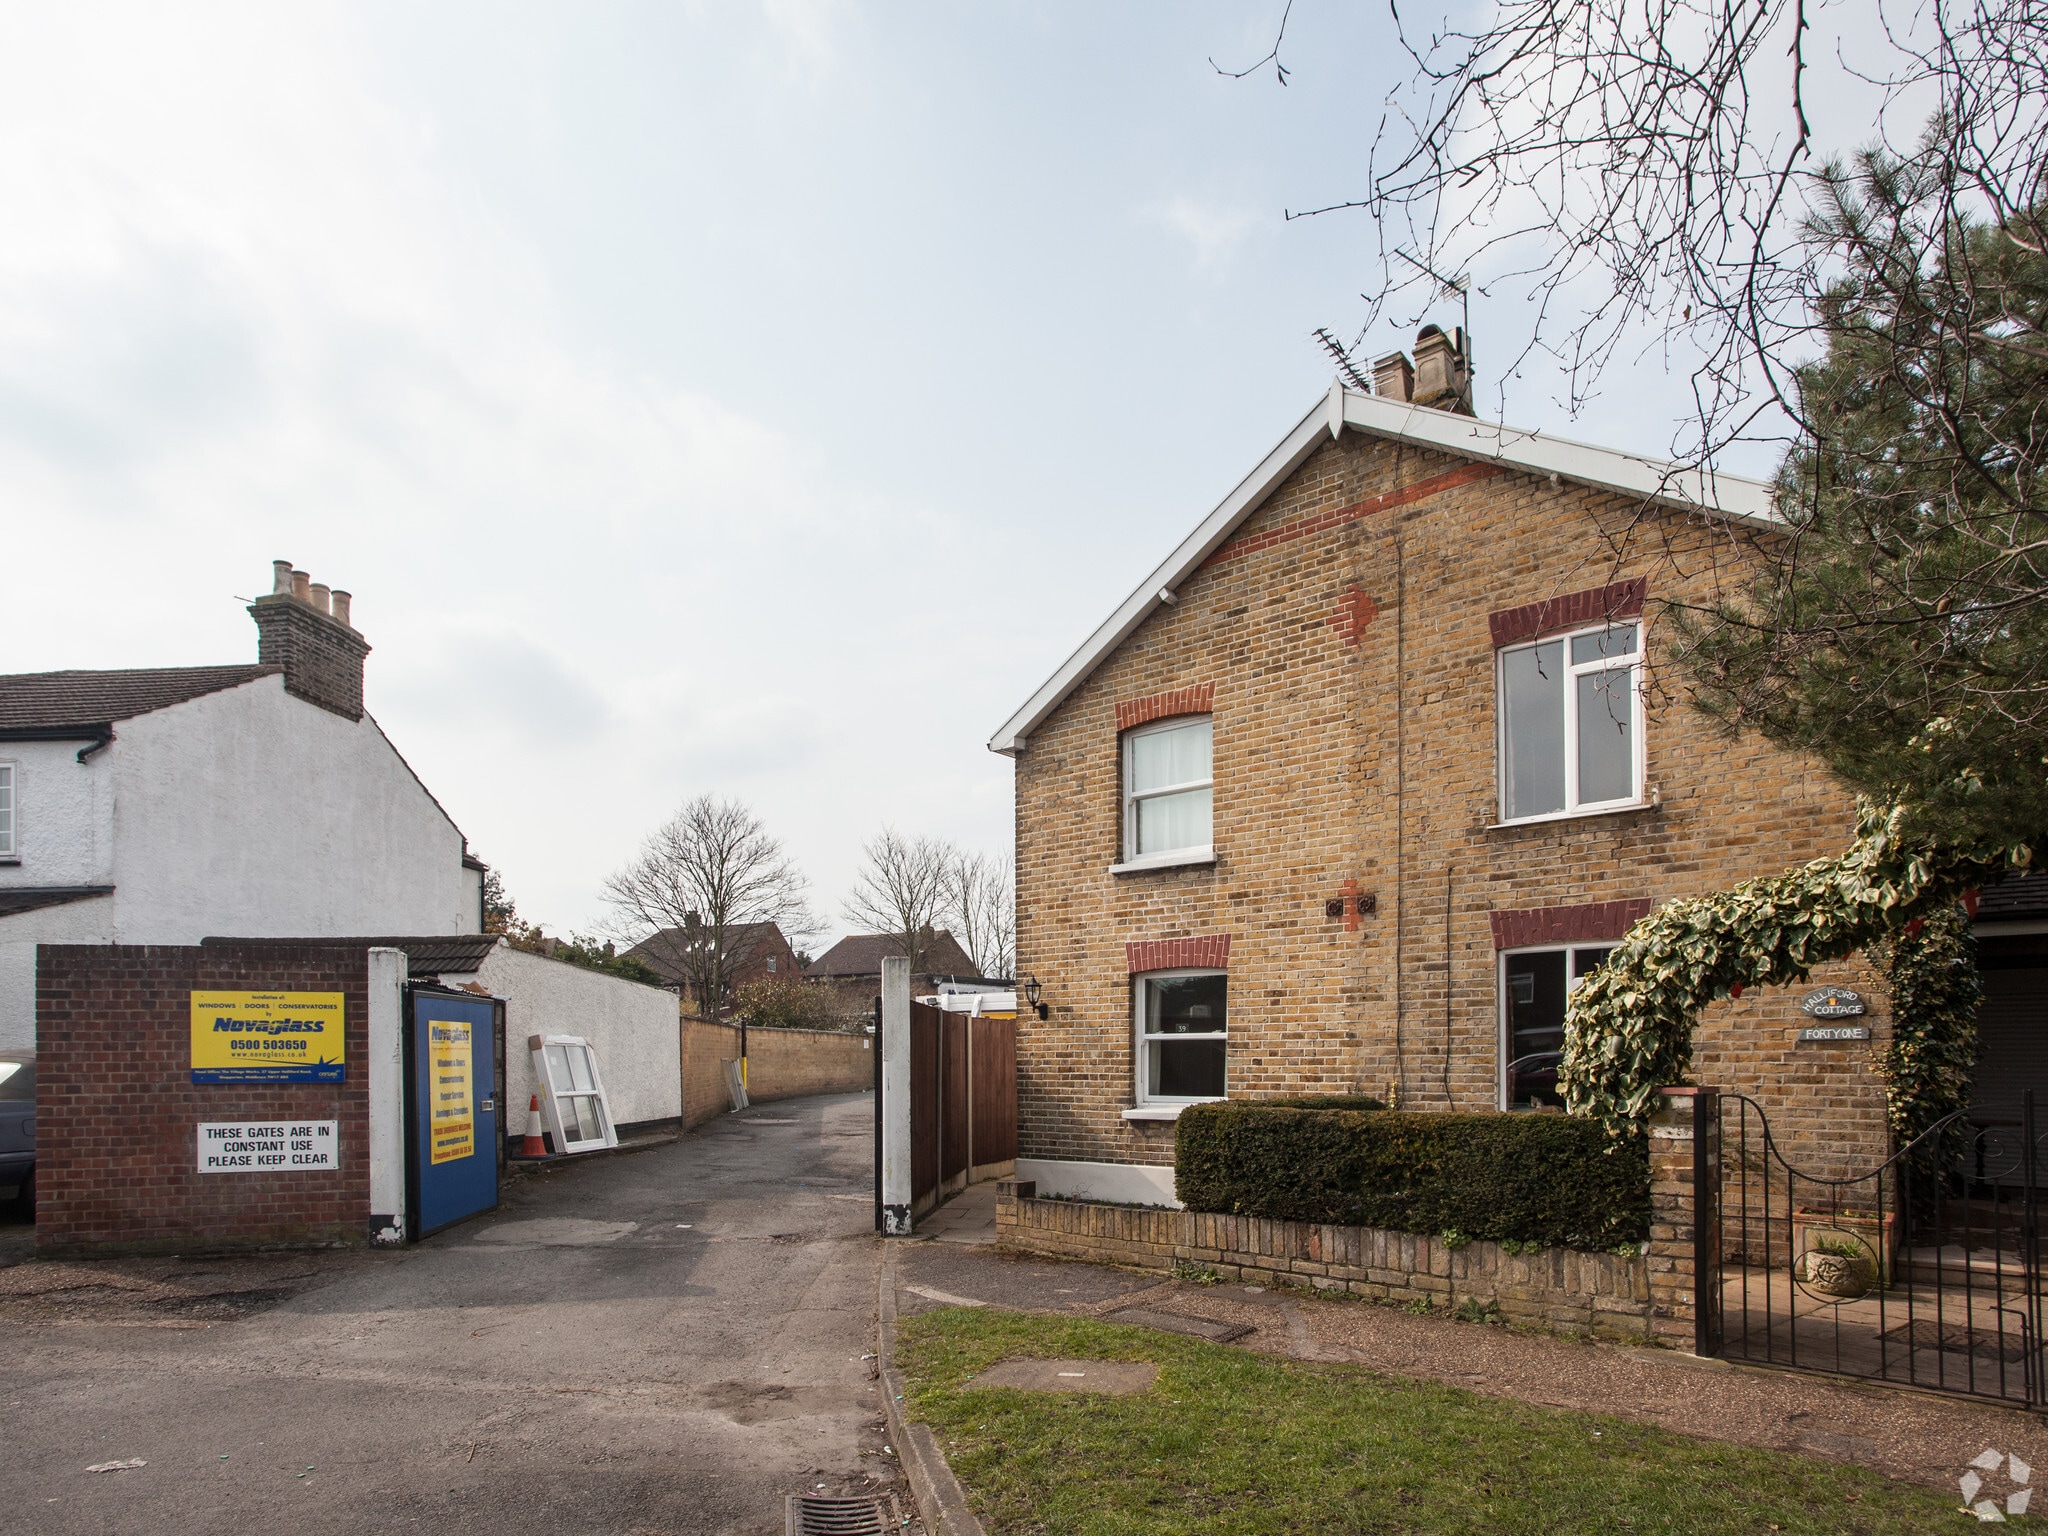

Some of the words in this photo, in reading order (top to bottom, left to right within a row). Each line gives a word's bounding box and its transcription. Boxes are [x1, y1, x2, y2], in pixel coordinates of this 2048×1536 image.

[1802, 989, 1858, 1011] HALLIFORD
[1814, 1005, 1863, 1015] COTTAGE
[213, 1017, 325, 1035] Novaglass
[431, 1026, 470, 1043] Novaglass
[231, 1039, 260, 1050] 0500
[263, 1039, 307, 1050] 503650
[206, 1128, 242, 1139] THESE
[248, 1127, 284, 1138] GATES
[290, 1127, 312, 1137] ARE
[318, 1126, 330, 1136] IN
[224, 1141, 285, 1152] CONSTANT
[291, 1140, 313, 1151] USE
[208, 1156, 252, 1166] PLEASE
[258, 1155, 286, 1165] KEEP
[292, 1154, 328, 1164] CLEAR
